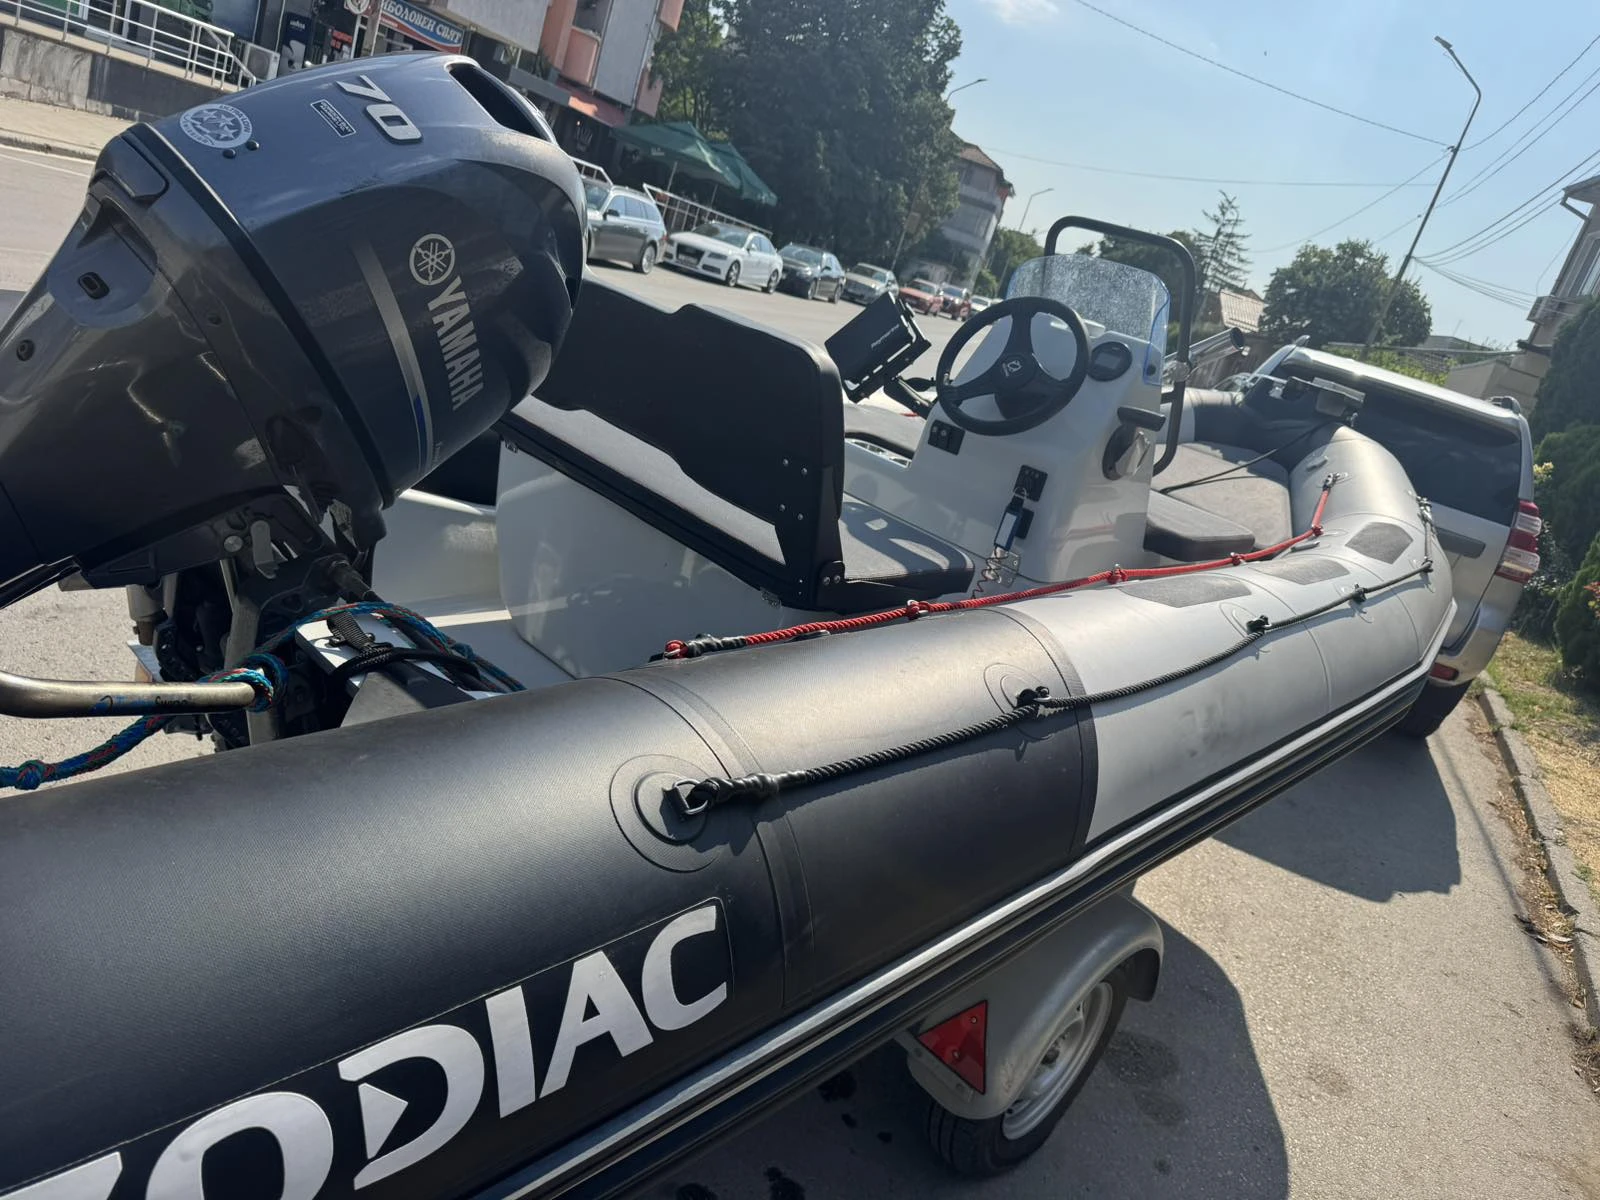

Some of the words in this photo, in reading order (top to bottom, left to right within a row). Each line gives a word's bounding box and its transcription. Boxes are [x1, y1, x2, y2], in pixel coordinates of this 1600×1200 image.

[334, 74, 422, 141] 70
[428, 275, 484, 411] YAMAHA
[0, 905, 728, 1200] ODIAC
